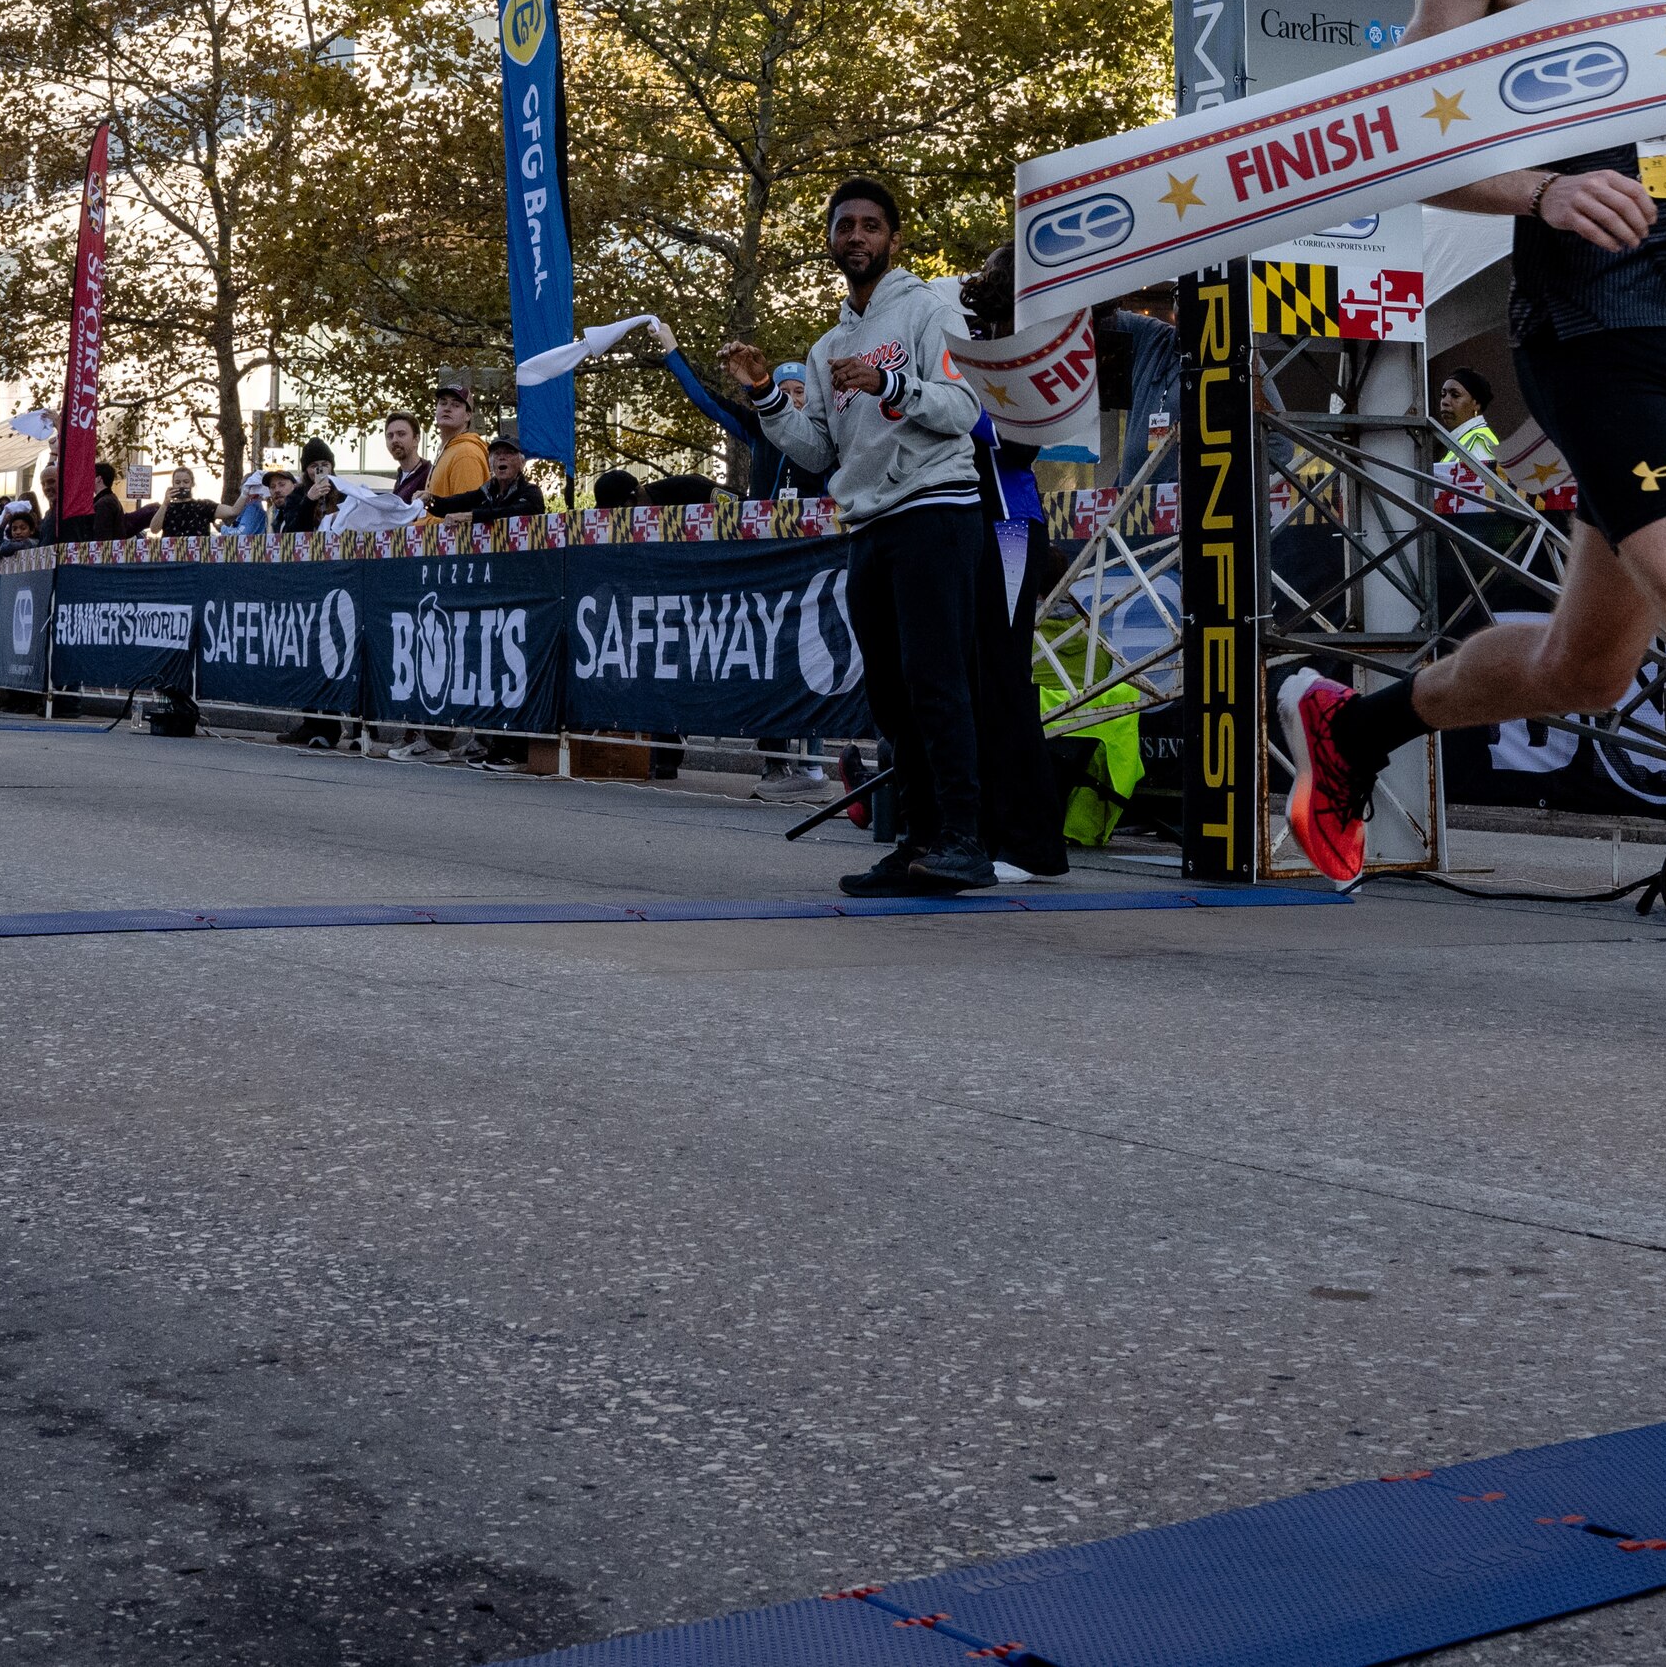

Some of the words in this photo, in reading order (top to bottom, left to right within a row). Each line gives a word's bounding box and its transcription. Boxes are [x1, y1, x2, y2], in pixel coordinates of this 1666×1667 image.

[1260, 8, 1361, 47] CareFirst
[520, 82, 541, 182] CFG
[1225, 104, 1400, 203] FINISH
[523, 188, 547, 302] Bank
[1298, 239, 1336, 249] CORRIGAN
[1336, 242, 1362, 251] SPORTS
[79, 252, 101, 430] SPORTS
[422, 561, 491, 585] PIZZA
[55, 602, 134, 646] RUNNER'S
[135, 609, 189, 642] WORLD
[202, 599, 317, 668] SAFEWAY
[575, 589, 793, 682] SAFEWAY
